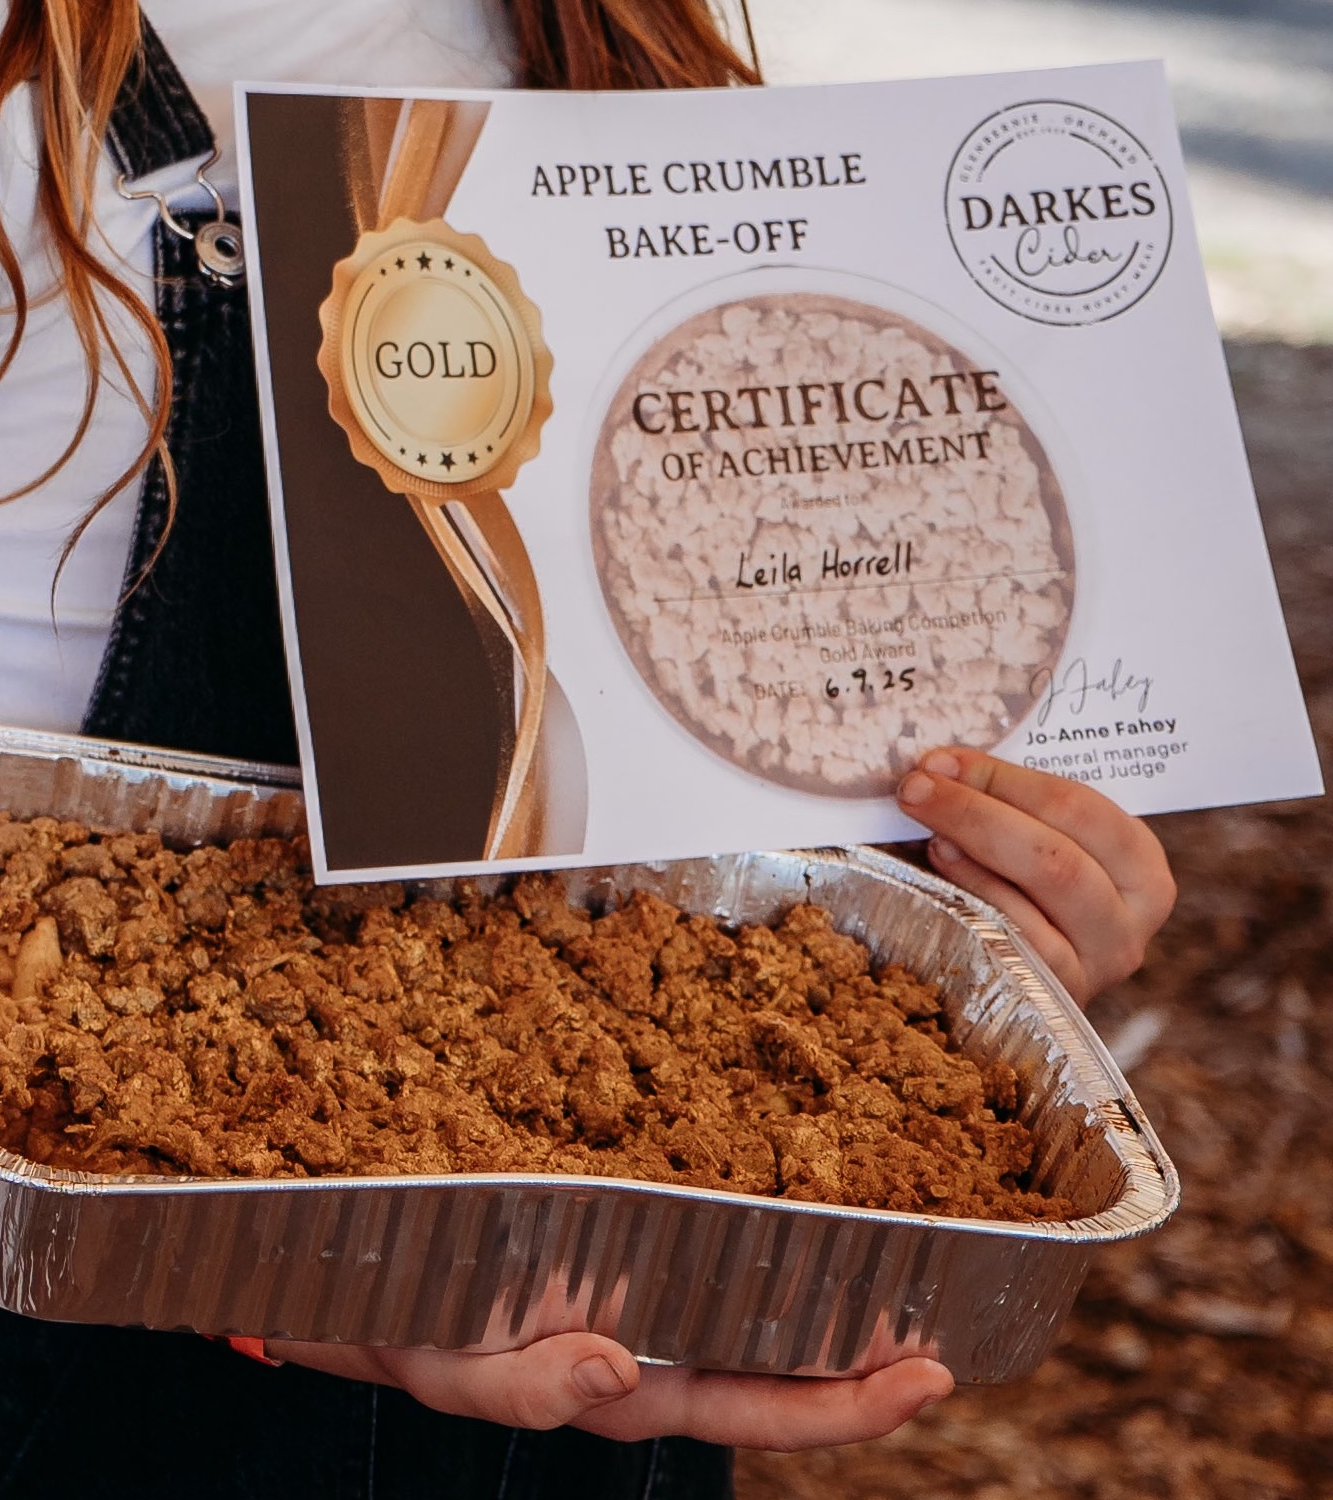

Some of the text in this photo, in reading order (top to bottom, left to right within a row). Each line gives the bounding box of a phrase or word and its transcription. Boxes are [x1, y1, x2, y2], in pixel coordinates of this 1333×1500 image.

[531, 153, 867, 198] APPLE CRUMBLE
[959, 181, 1156, 231] DARKES
[604, 218, 810, 260] BAKE-OFF
[1015, 225, 1123, 277] Cider
[375, 341, 497, 379] GOLD
[632, 370, 1008, 435] CERTIFICATE
[661, 431, 991, 482] OF ACHIEVEMENT
[735, 541, 912, 589] Leila Horrell
[721, 627, 768, 646] Apple
[770, 621, 840, 644] Crumble
[845, 614, 904, 637] Baking
[819, 641, 917, 664] Gold Award
[1025, 717, 1177, 746] Jo-Anne Fahey
[1023, 741, 1189, 770] General manager
[1108, 760, 1167, 779] Judge
